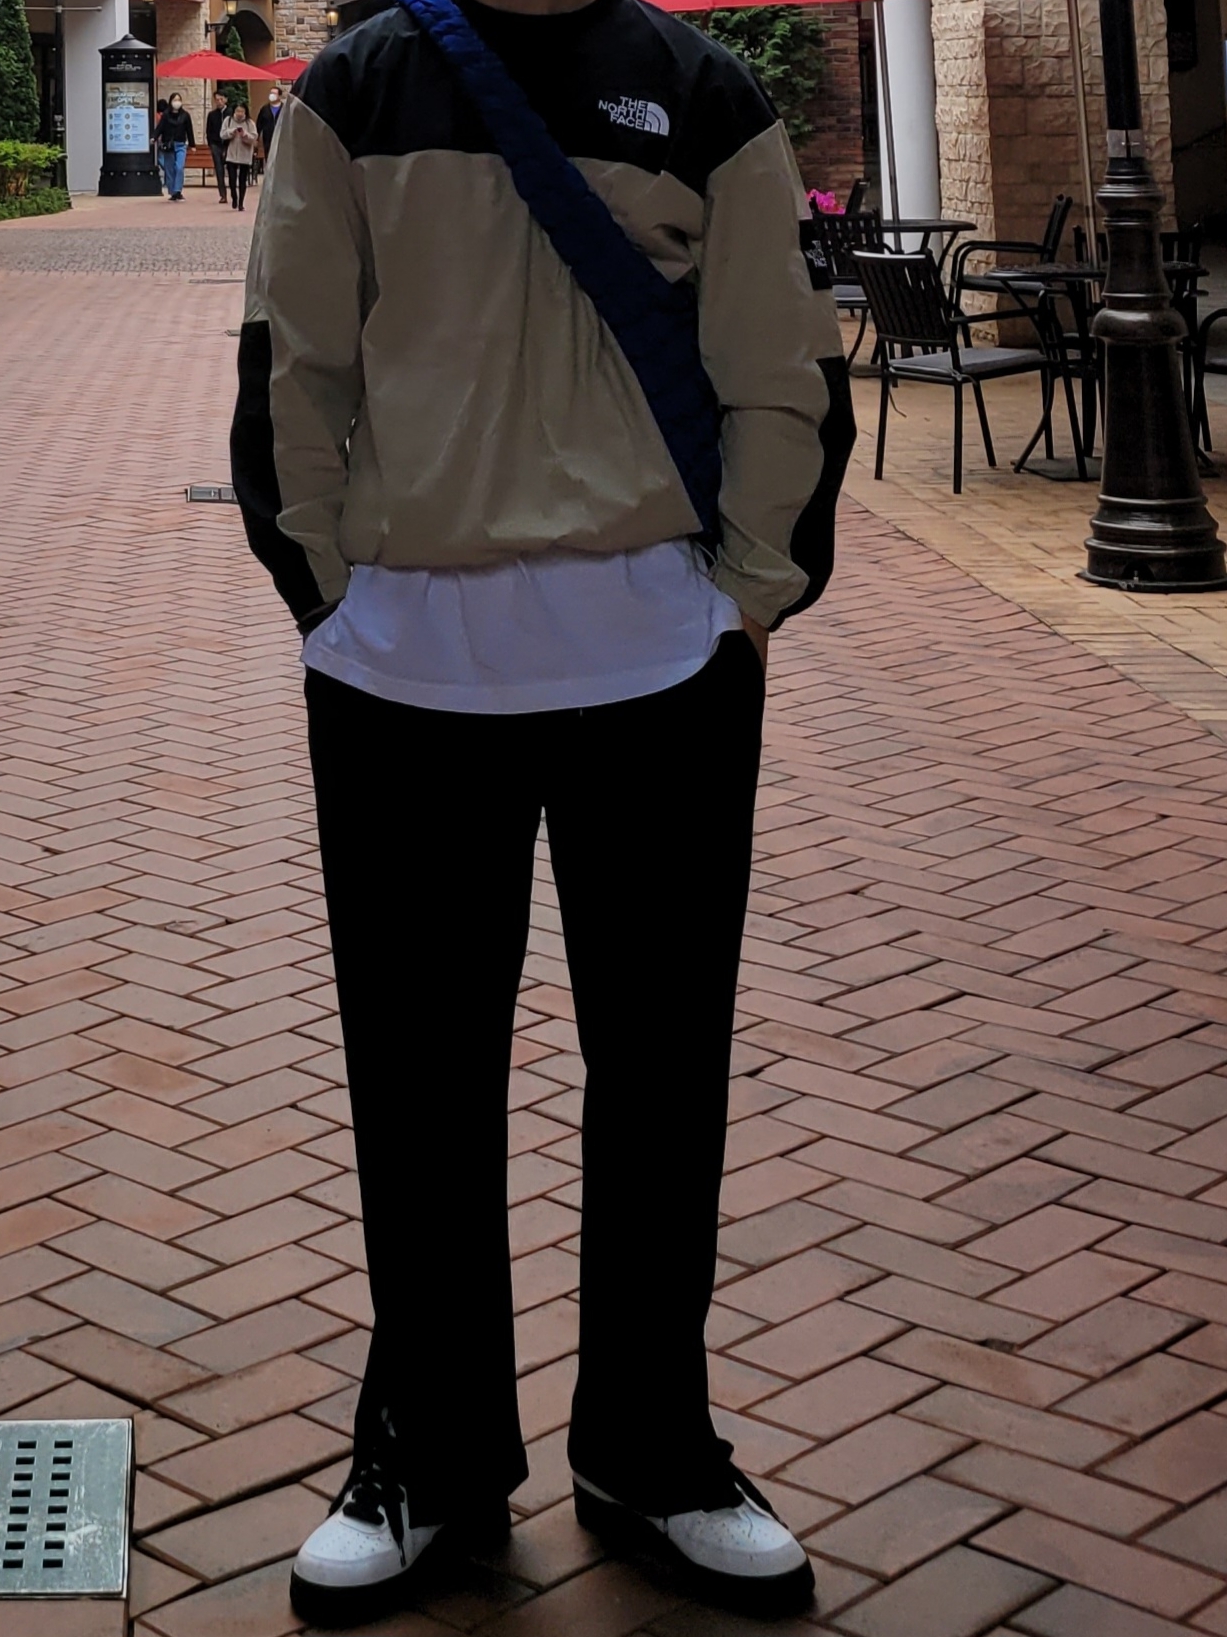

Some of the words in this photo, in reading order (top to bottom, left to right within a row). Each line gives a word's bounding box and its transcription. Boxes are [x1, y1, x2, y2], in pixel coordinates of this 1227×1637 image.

[598, 100, 646, 121] NORTH
[619, 96, 647, 111] THE
[610, 112, 645, 130] FACE
